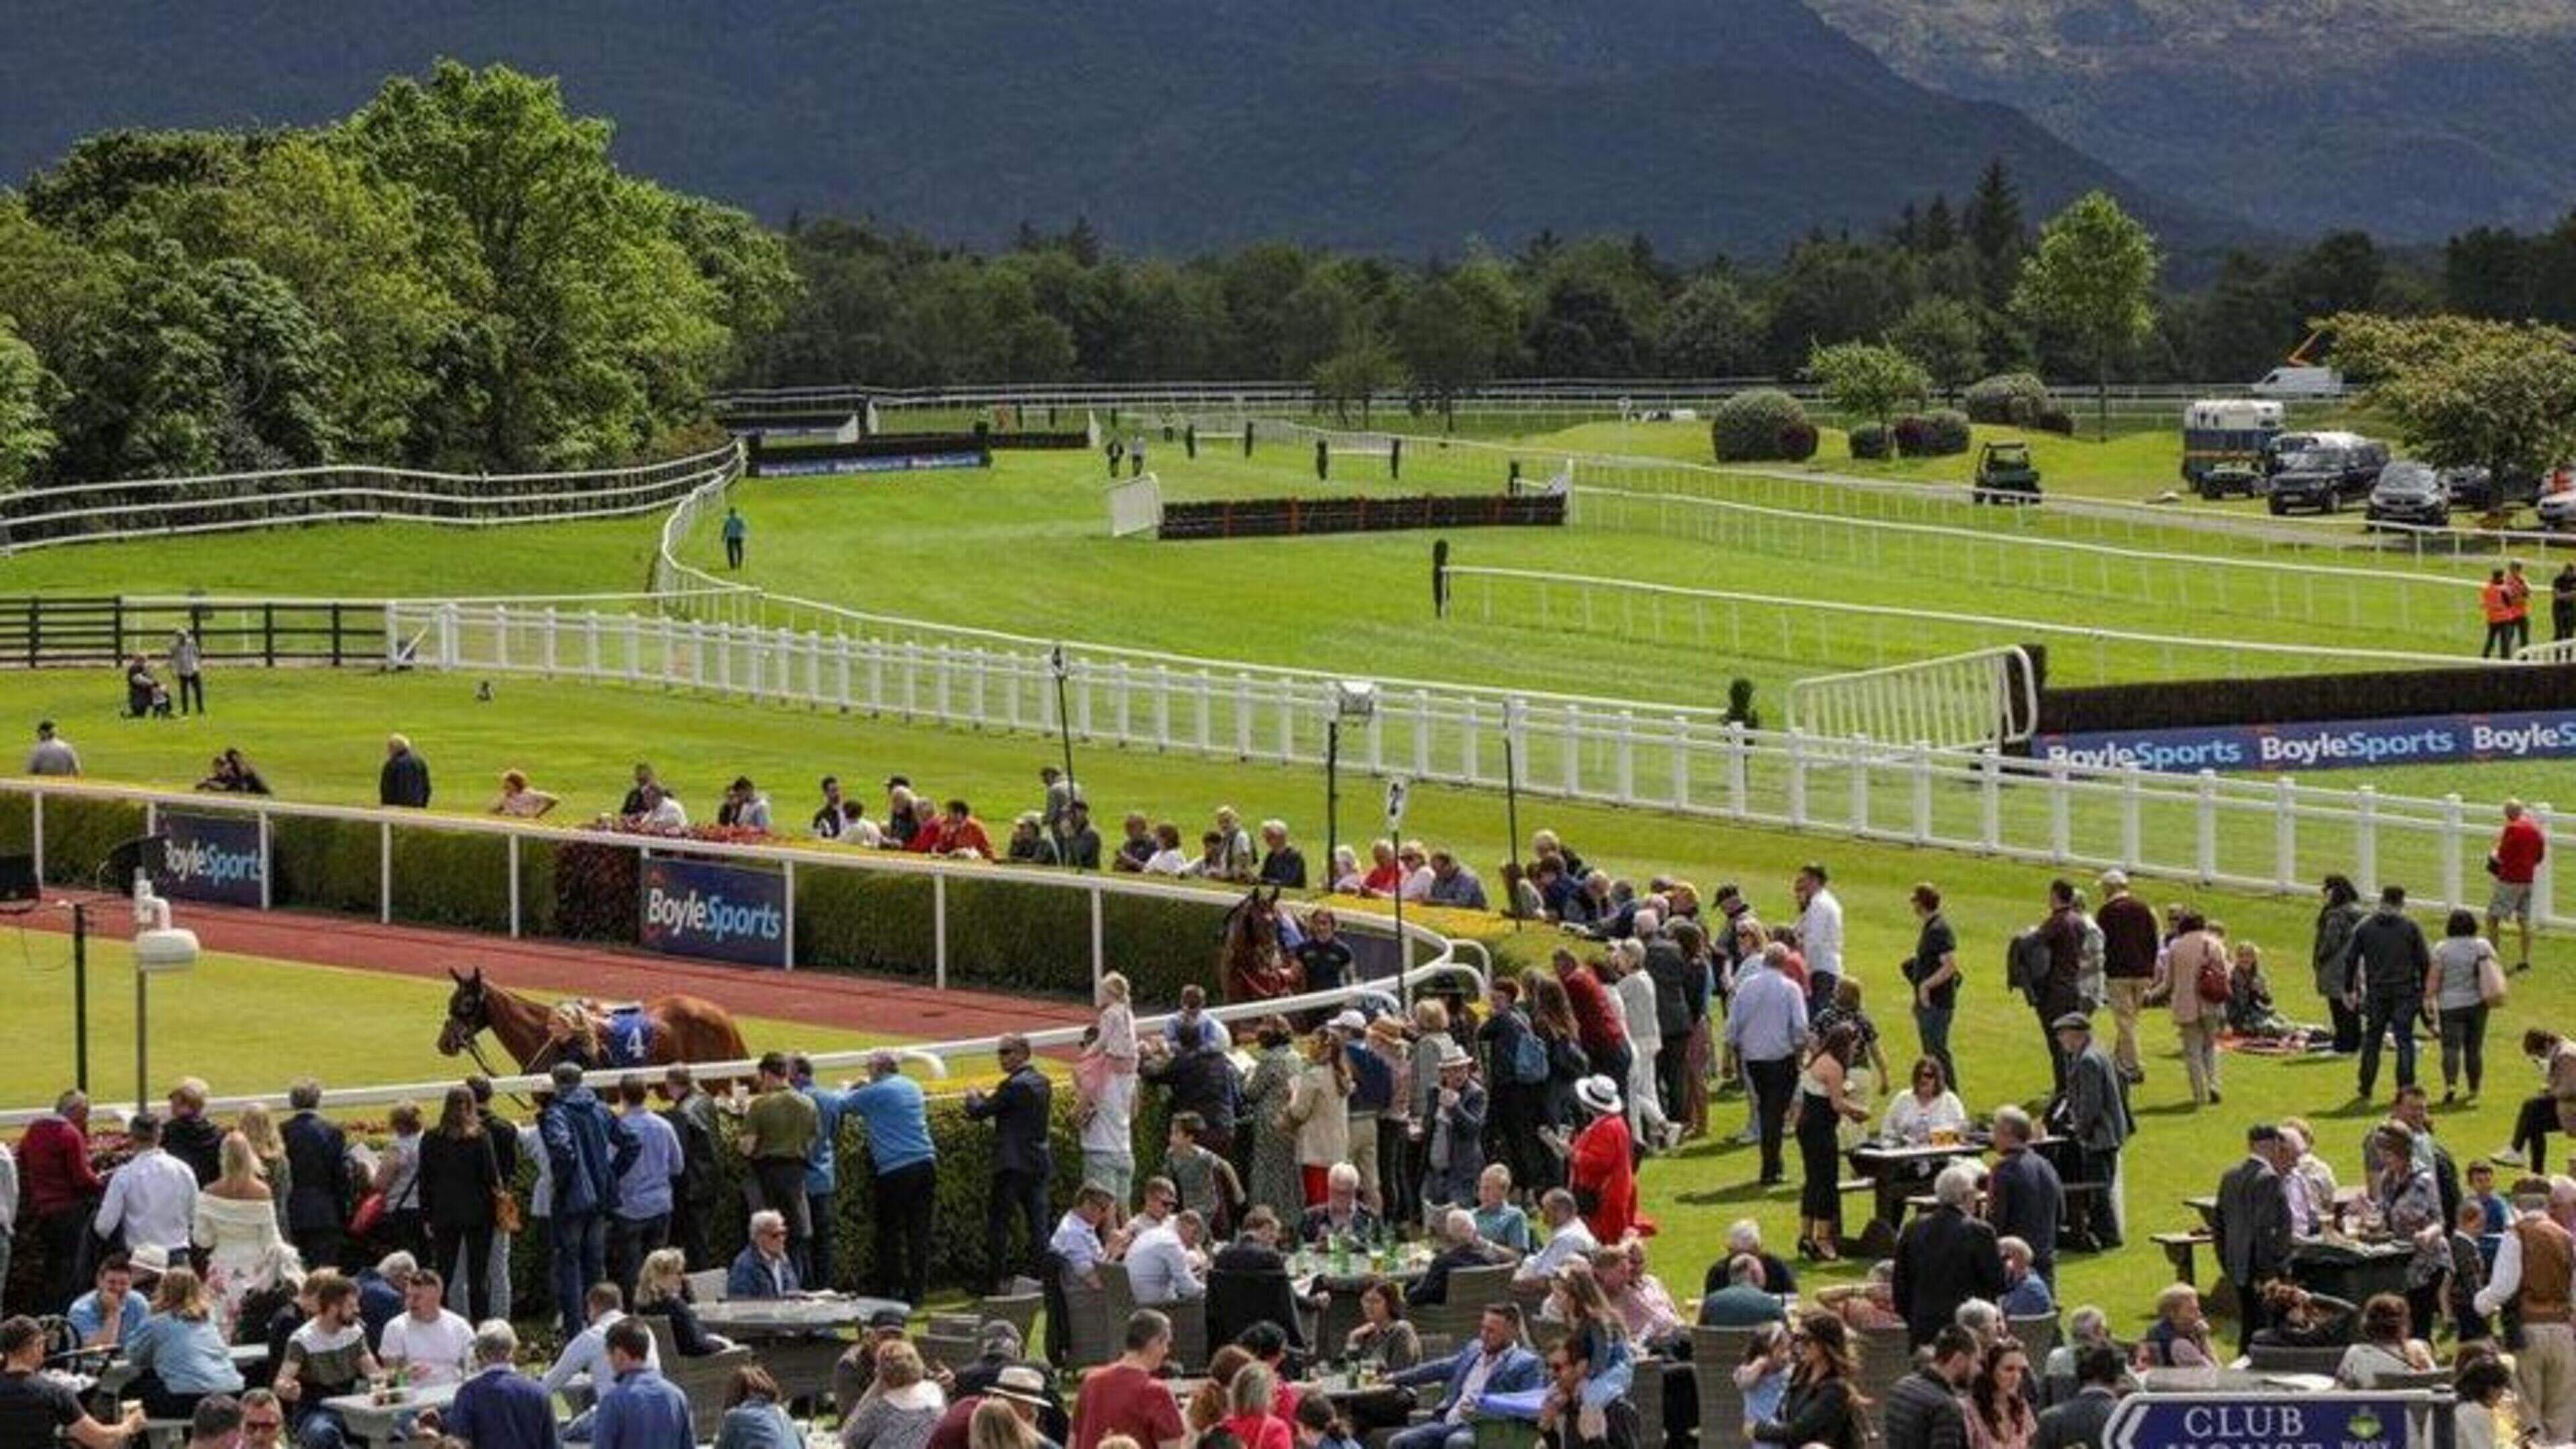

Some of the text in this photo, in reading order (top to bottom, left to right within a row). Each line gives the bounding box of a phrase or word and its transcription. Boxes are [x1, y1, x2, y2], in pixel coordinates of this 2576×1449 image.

[2261, 729, 2454, 764] BoyleSports
[164, 839, 262, 885] oyleSport
[649, 888, 782, 942] BoyleSports
[627, 1027, 645, 1059] 4
[2184, 1406, 2304, 1438] CLUB
